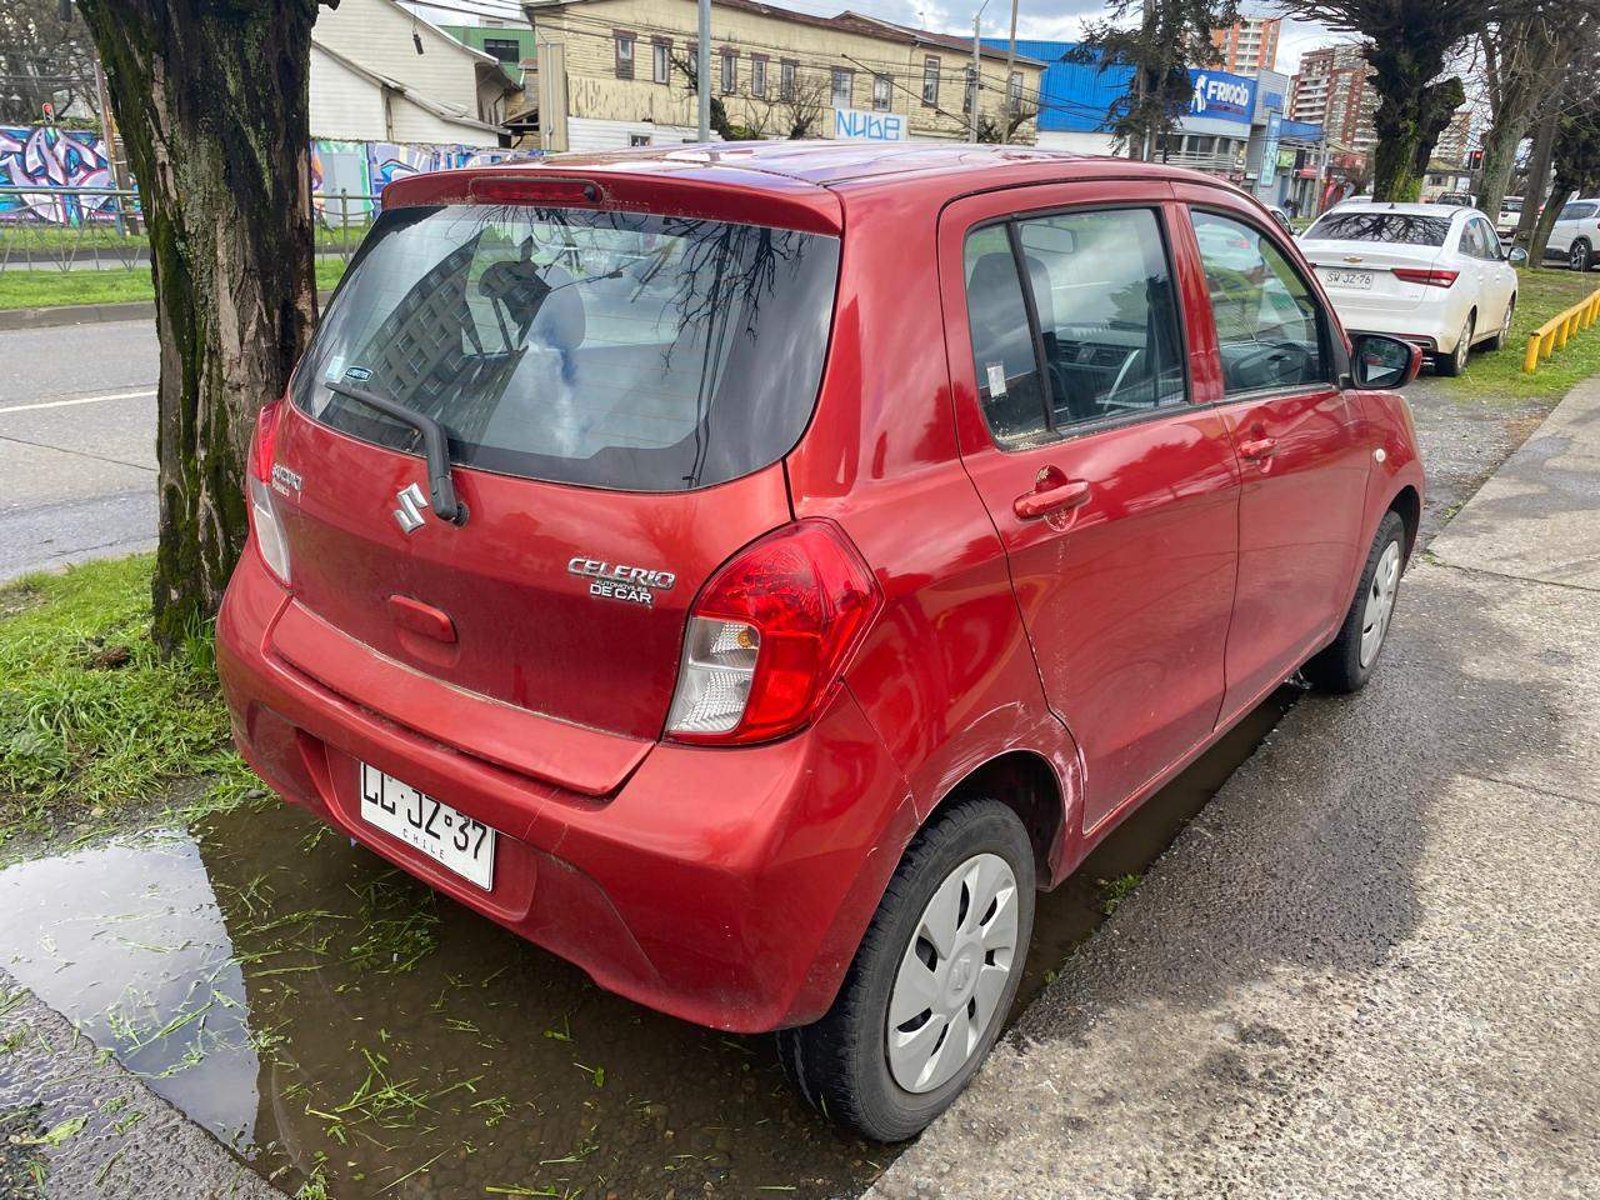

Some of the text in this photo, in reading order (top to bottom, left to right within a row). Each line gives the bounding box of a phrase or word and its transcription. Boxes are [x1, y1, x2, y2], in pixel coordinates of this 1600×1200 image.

[568, 557, 676, 589] CELERIO
[590, 583, 652, 604] DE CAR
[402, 828, 445, 860] CHILE
